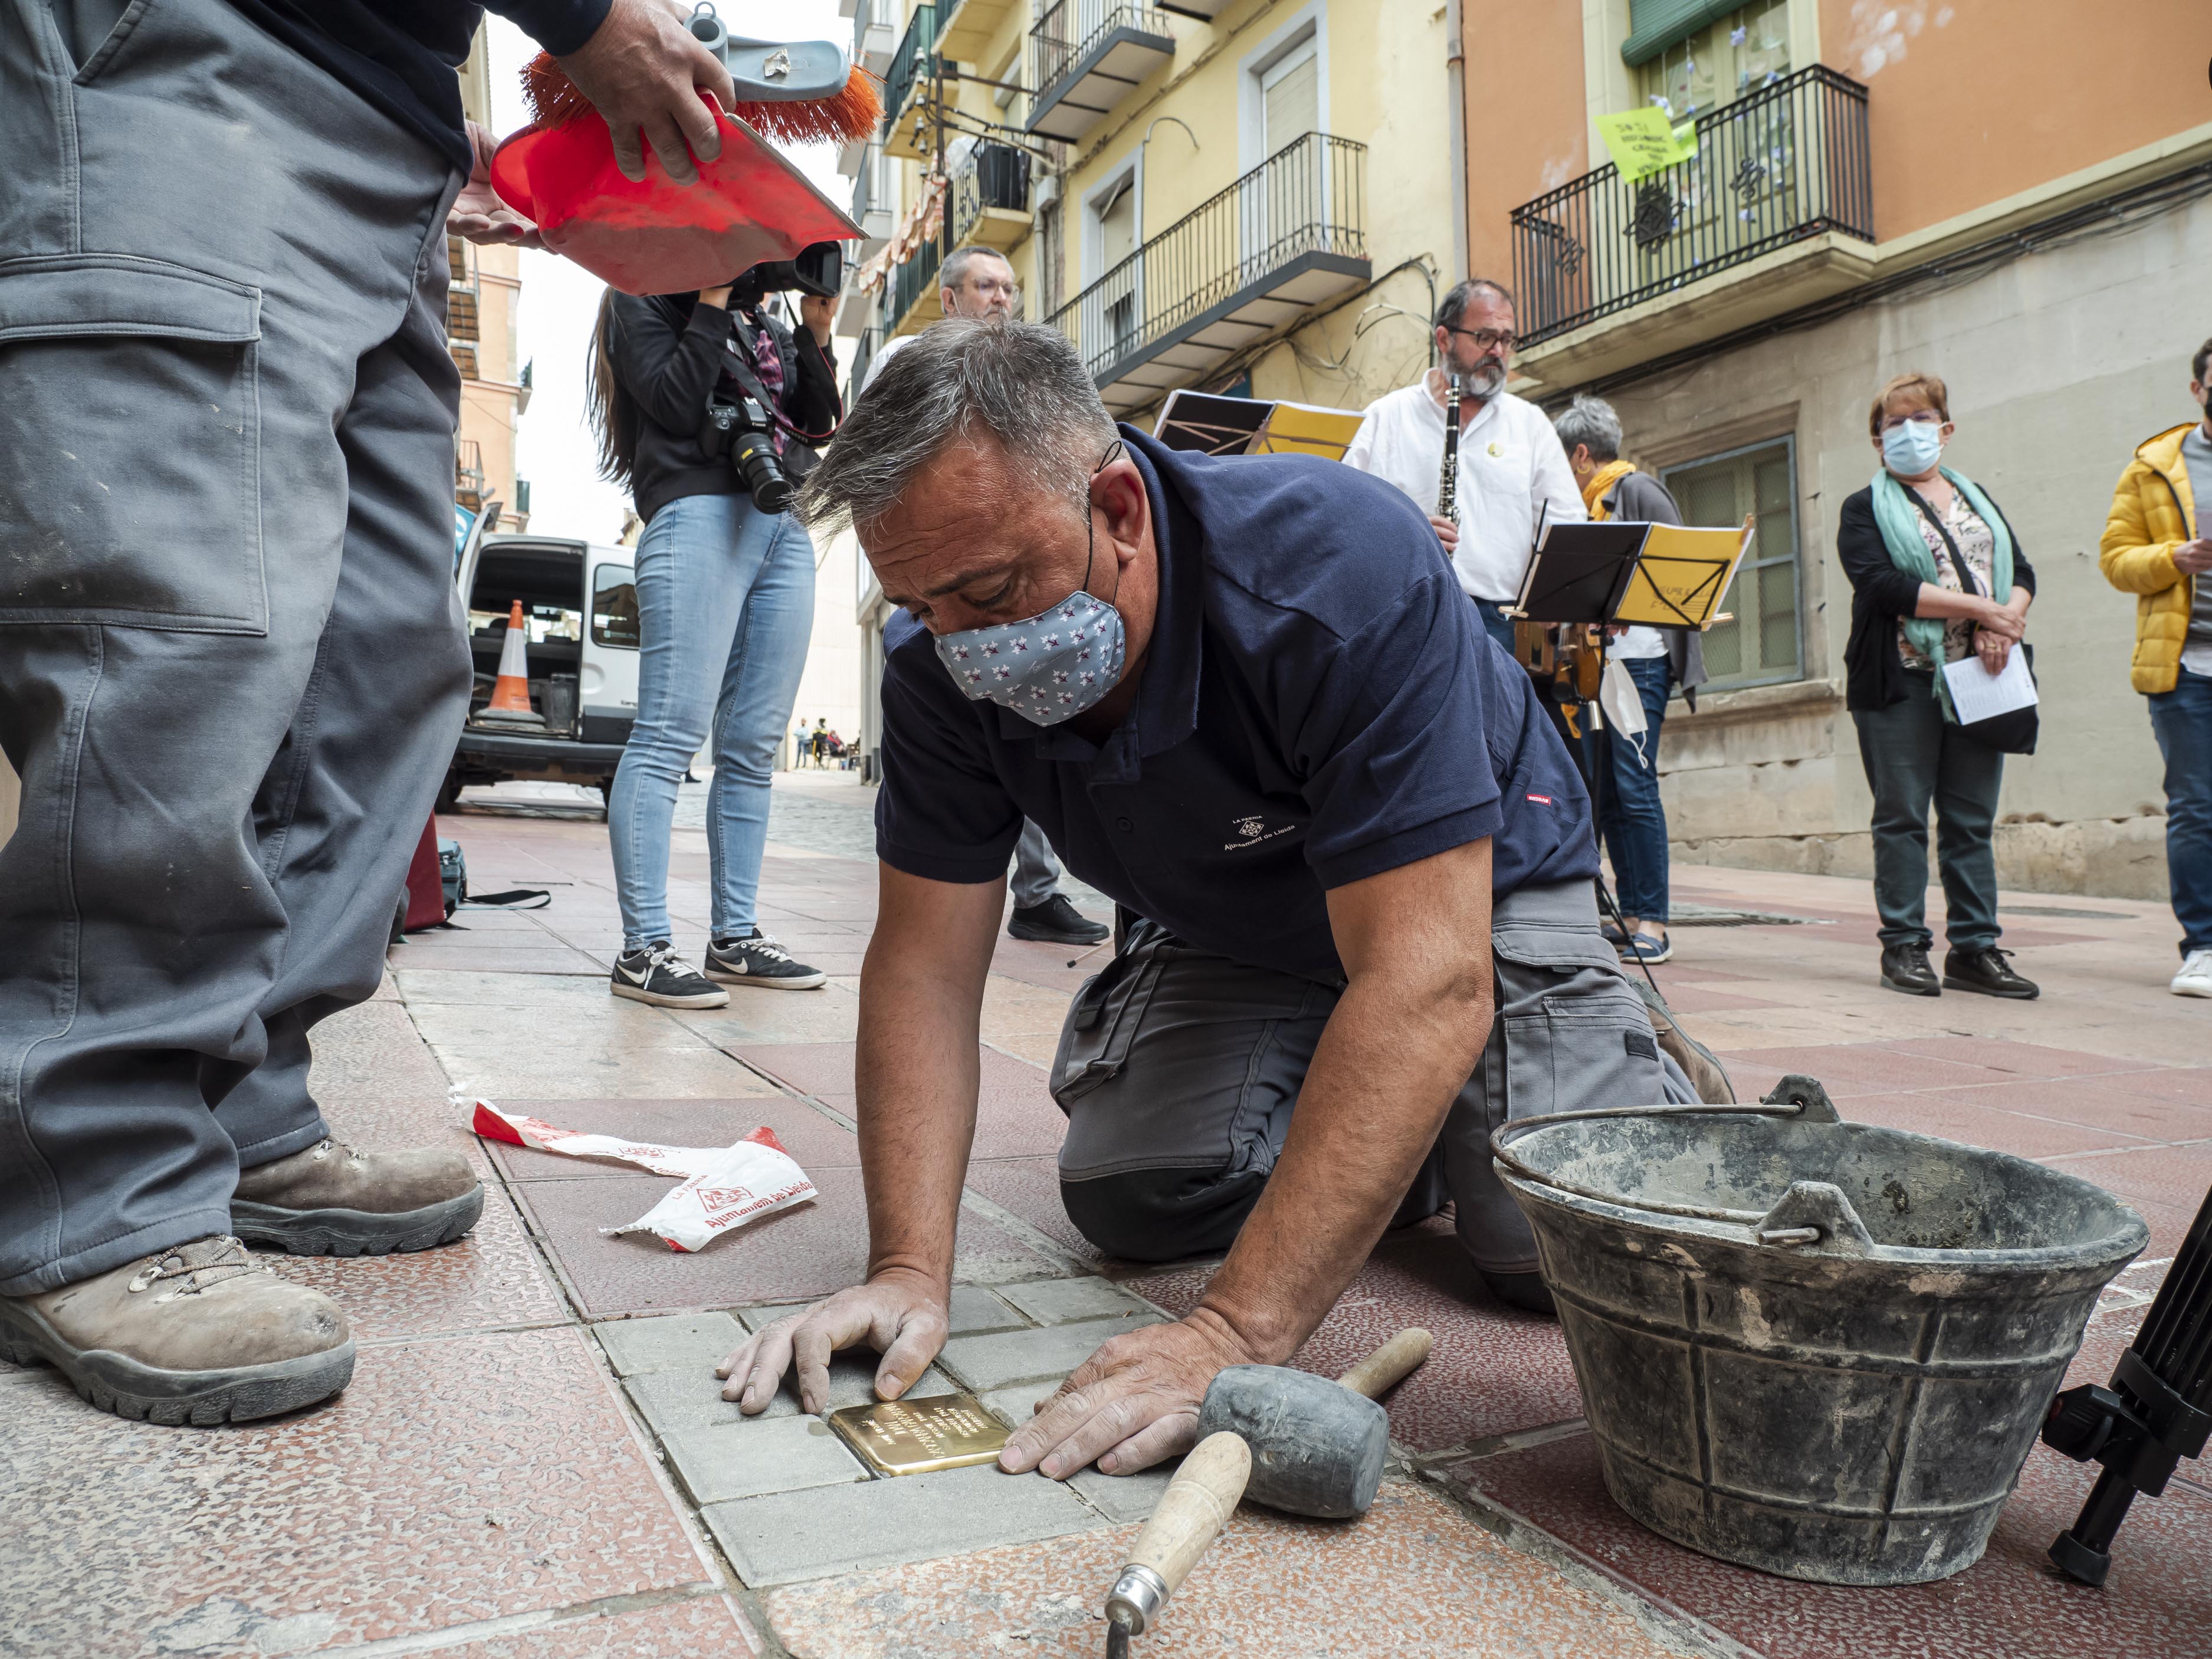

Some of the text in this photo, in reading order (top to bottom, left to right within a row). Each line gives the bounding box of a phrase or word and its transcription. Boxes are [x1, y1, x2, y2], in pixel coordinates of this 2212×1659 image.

[1225, 836, 1262, 851] Ajuntament
[1274, 824, 1295, 836] Lleida
[649, 1165, 693, 1178] leida
[672, 1174, 708, 1200] LA PAERIA
[704, 1181, 815, 1228] Ajuntament de Lleida
[884, 1421, 909, 1435] JOAN
